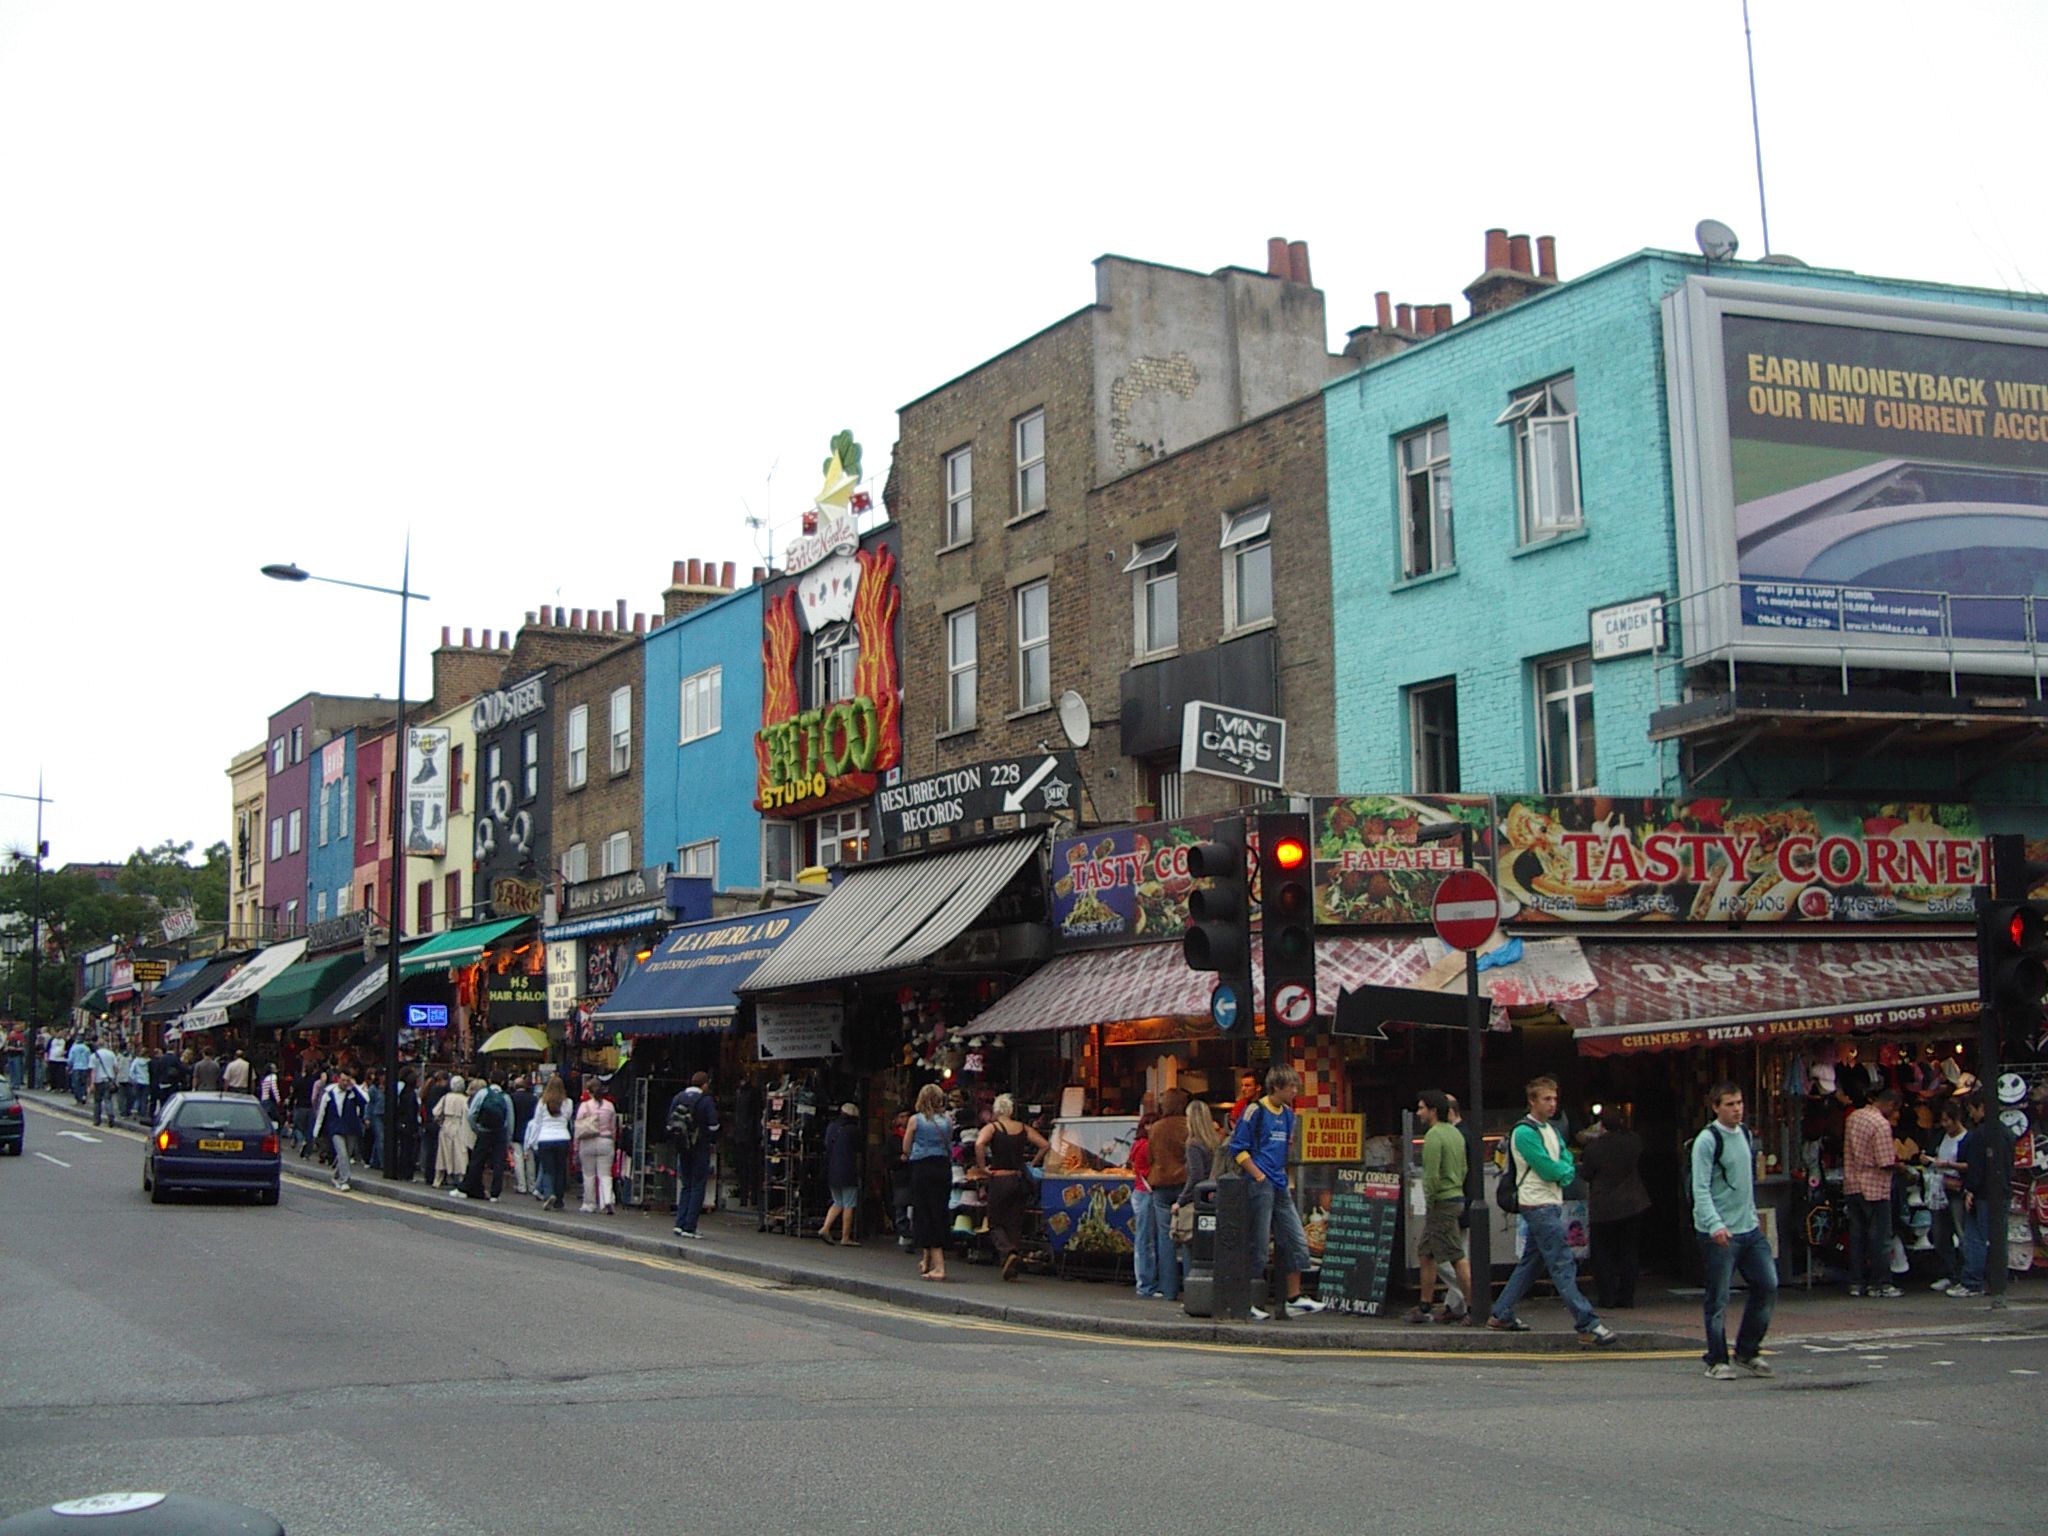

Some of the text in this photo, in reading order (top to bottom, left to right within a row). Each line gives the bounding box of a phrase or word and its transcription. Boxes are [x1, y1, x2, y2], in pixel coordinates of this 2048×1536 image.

[1748, 353, 1820, 390] EARN
[1827, 363, 1988, 406] MONEYBACK
[1750, 386, 1802, 420] OUR
[1809, 393, 1866, 426] NEW
[1875, 400, 1986, 437] CURRENT
[1606, 613, 1648, 635] CAMDEN
[1907, 606, 1940, 617] purchase
[1618, 633, 1630, 649] ST
[760, 696, 877, 788] TATTOO
[1202, 731, 1272, 761] CABS
[762, 771, 826, 809] STUDIO
[880, 764, 1020, 813] RESURRECTION 228
[902, 798, 965, 833] RECORDS
[1343, 848, 1464, 869] FALAFEL
[1561, 833, 1757, 883] TASTY
[1072, 853, 1148, 891] TASTY
[1719, 896, 1748, 912] HOT
[1755, 896, 1786, 912] DOG
[668, 918, 790, 953] LEATHERLAND
[1631, 962, 1799, 983] TASTY
[489, 991, 513, 1001] HAIR
[1622, 1002, 1981, 1048] CHINESE PIZZA FALAFEL HOT DOGS BURG
[1310, 1117, 1355, 1129] A VARIETY
[1307, 1132, 1357, 1144] OF CHILLED
[1307, 1146, 1357, 1158] FOODS ARE
[1338, 1169, 1400, 1185] TASTY CORNER
